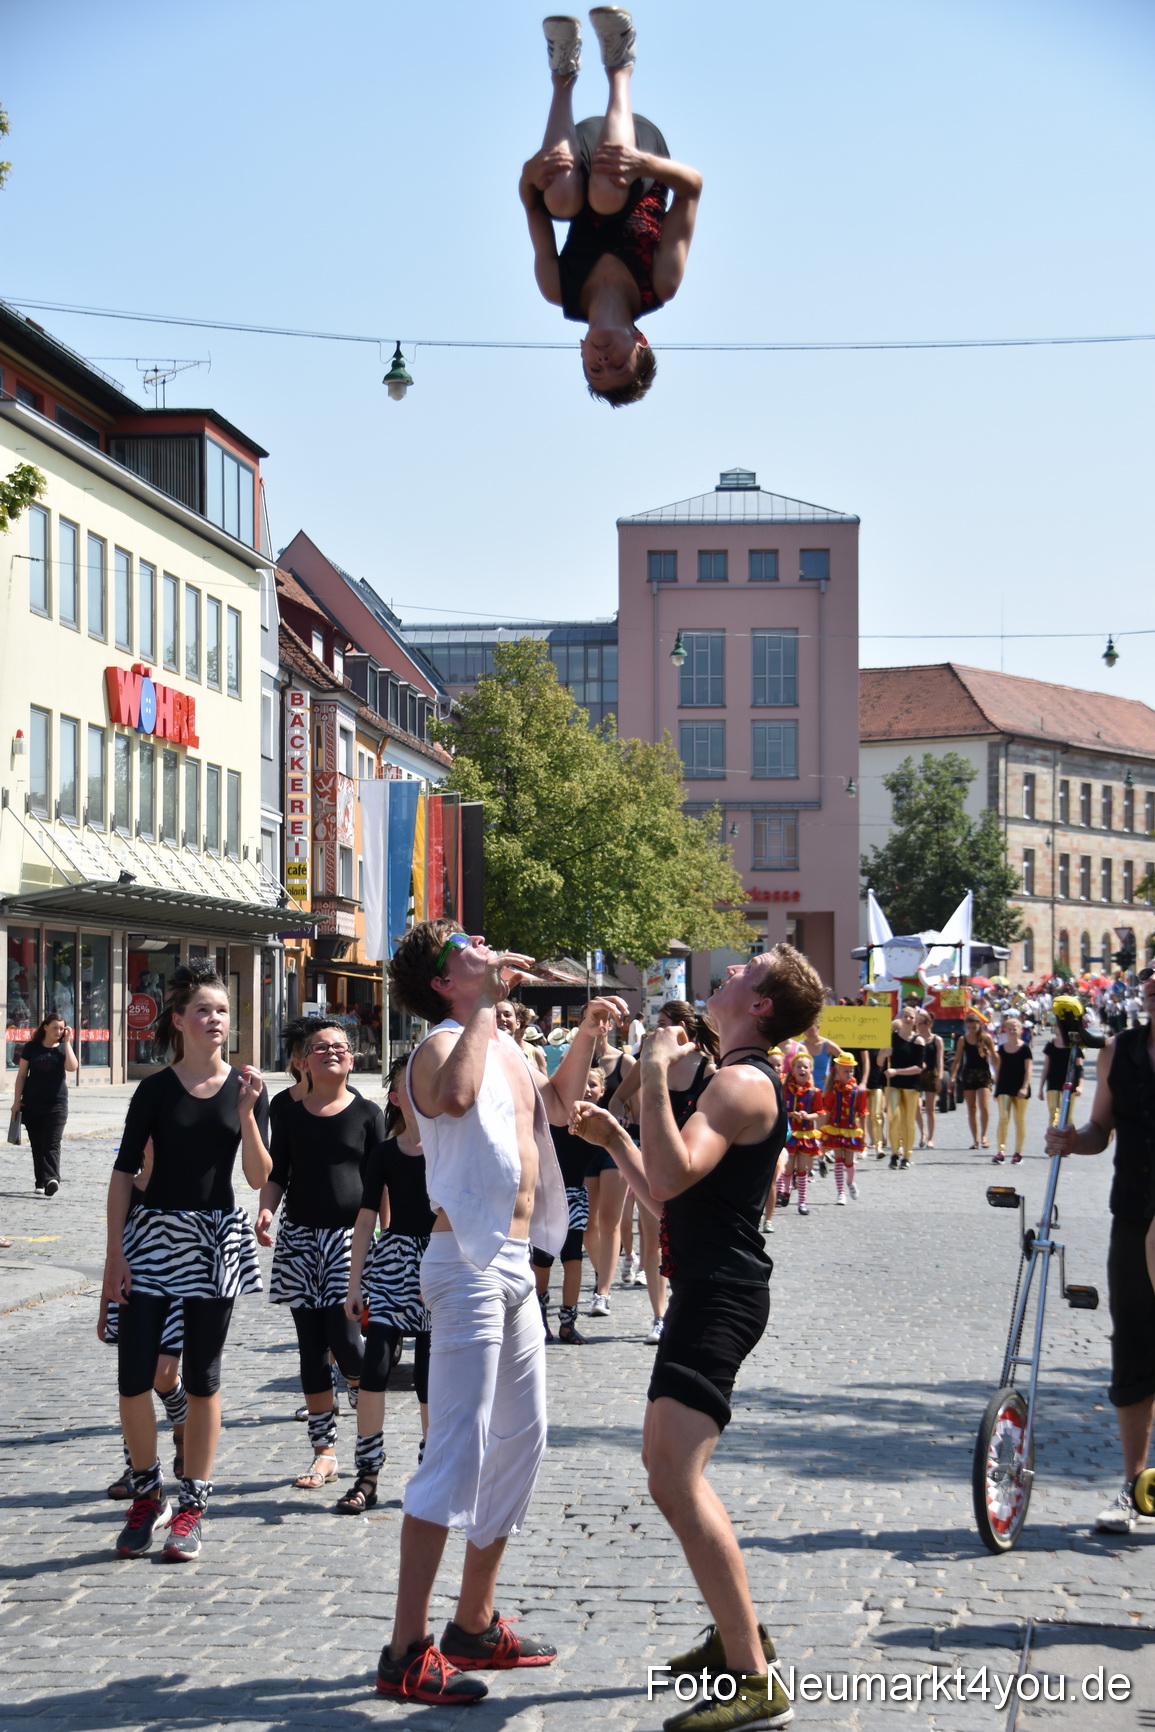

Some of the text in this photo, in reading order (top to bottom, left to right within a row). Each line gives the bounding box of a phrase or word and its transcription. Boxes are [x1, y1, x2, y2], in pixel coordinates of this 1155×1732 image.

[105, 663, 200, 749] WÖHRL
[290, 693, 305, 856] BÄCKEREI
[287, 864, 307, 876] café
[129, 1005, 150, 1014] 25%
